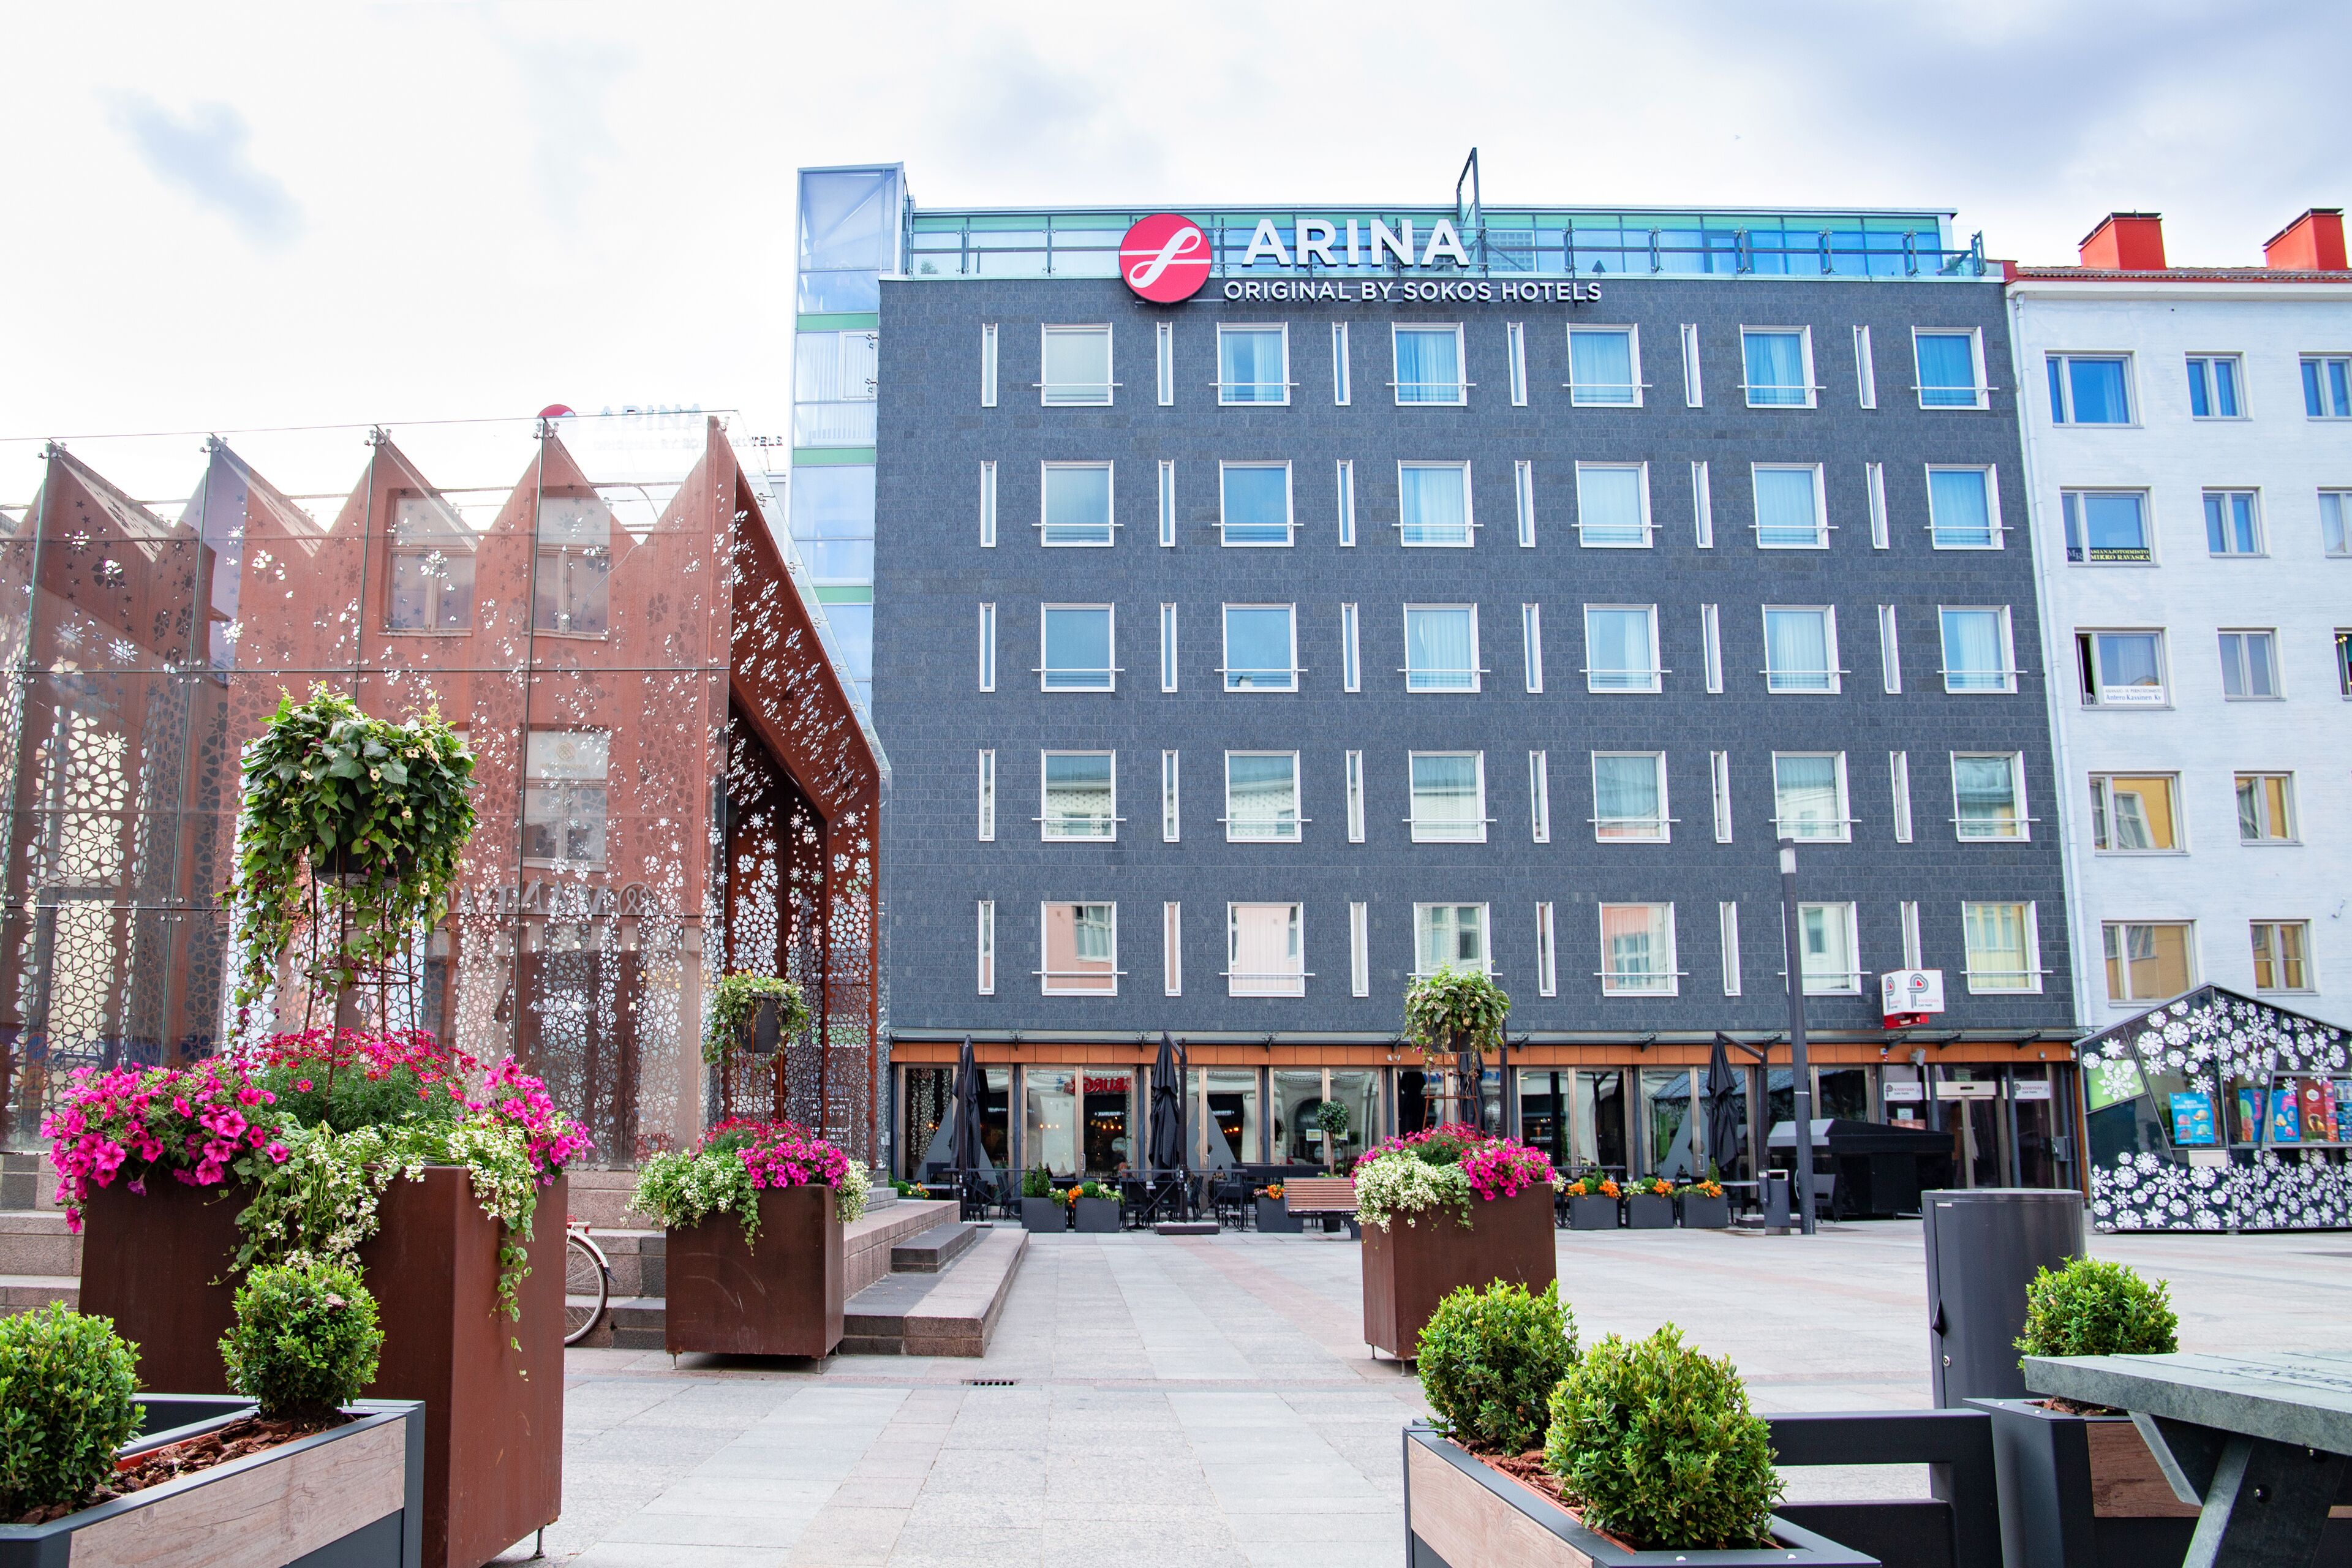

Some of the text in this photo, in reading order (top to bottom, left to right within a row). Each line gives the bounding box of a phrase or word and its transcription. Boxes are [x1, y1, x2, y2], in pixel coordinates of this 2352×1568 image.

[1242, 219, 1471, 266] ARINA
[1224, 281, 1602, 301] ORIGINAL BY SOKOS HOTELS
